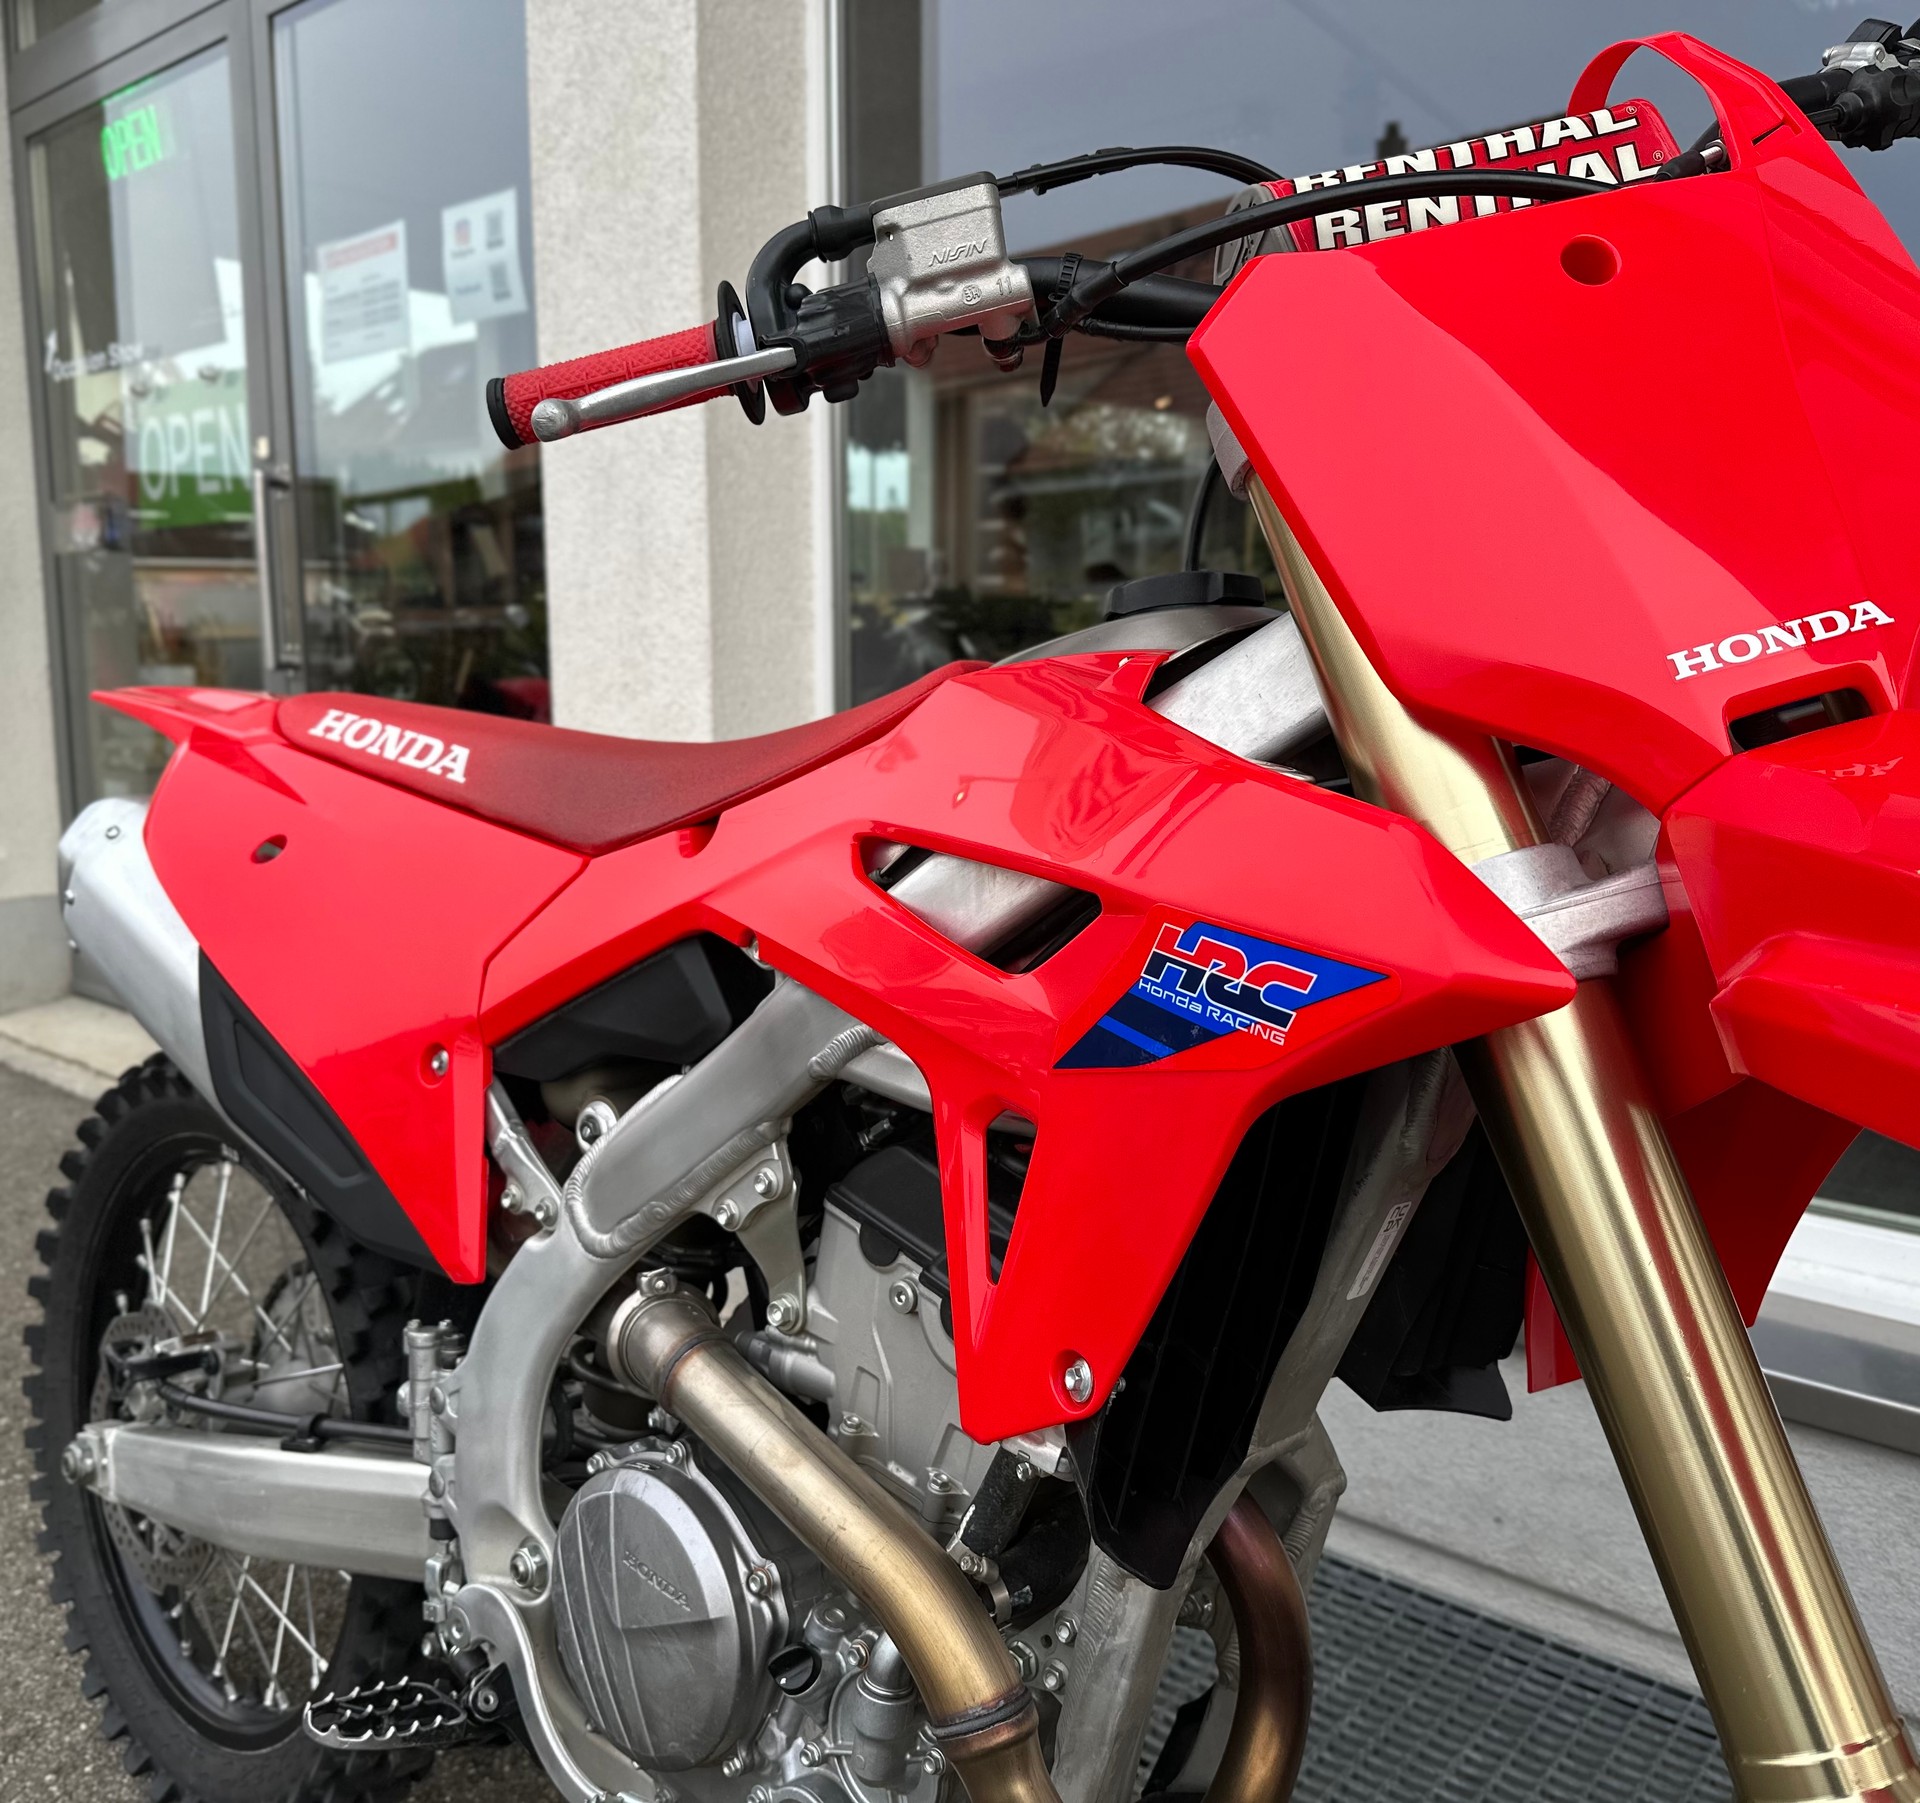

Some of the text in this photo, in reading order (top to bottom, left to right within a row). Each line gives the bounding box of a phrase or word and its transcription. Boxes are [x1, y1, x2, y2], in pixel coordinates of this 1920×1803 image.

[101, 104, 163, 181] OPEN
[139, 403, 252, 502] OPEN
[1666, 600, 1895, 681] HONDA
[307, 708, 471, 784] HONDA
[1138, 979, 1287, 1046] Honda RACING
[1140, 922, 1318, 1032] HRC
[622, 1550, 692, 1613] HONDA
